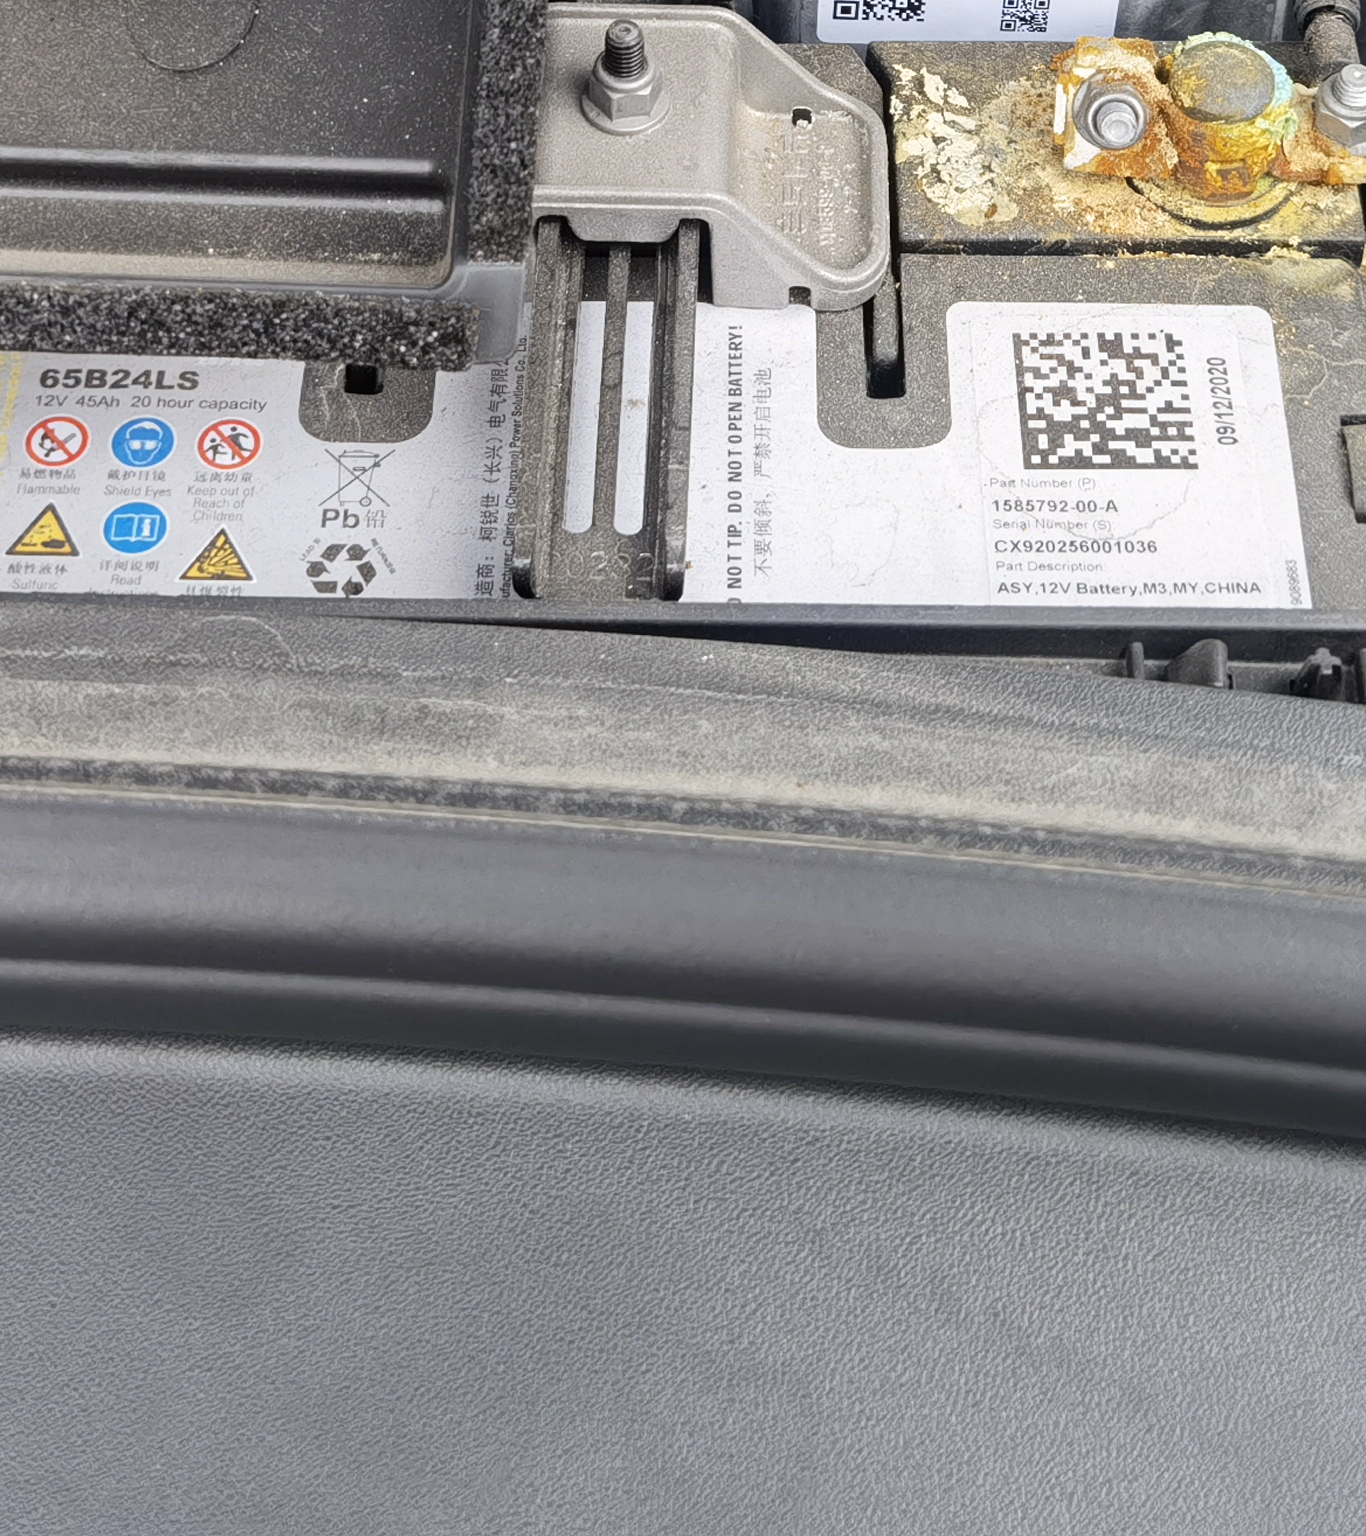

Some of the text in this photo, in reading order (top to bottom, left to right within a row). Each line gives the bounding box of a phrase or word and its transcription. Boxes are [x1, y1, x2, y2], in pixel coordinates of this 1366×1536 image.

[727, 325, 742, 397] BATTERY!
[39, 368, 201, 391] 65B24LS
[35, 394, 268, 413] 12V 45Ah 20 hour capacity
[511, 374, 525, 417] Solutions
[1206, 356, 1239, 446] 09/12/2020
[727, 401, 742, 444] OPEN
[509, 419, 522, 448] Power
[727, 449, 742, 483] NOT
[16, 483, 81, 495] Flammable
[103, 484, 172, 498] Shield Eyes
[187, 485, 256, 498] Keep out of
[989, 477, 1016, 488] Part
[1020, 478, 1072, 488] Number
[193, 497, 246, 509] Reach of
[727, 490, 742, 513] DO
[992, 499, 1118, 513] 1585792-00-A
[192, 510, 243, 522] Children
[320, 508, 360, 529] Pb
[364, 509, 388, 529] 铅
[992, 519, 1031, 530] Serial
[1035, 519, 1088, 530] Number
[503, 513, 517, 546] Clarios
[727, 521, 742, 549] TIP.
[994, 539, 1158, 554] CX920256001036
[727, 555, 742, 589] NOT
[995, 561, 1023, 571] Part
[11, 578, 59, 591] Sulfuric
[110, 573, 142, 586] Read
[997, 581, 1262, 597] ASY,12V Battery,M3,MY,CHINA
